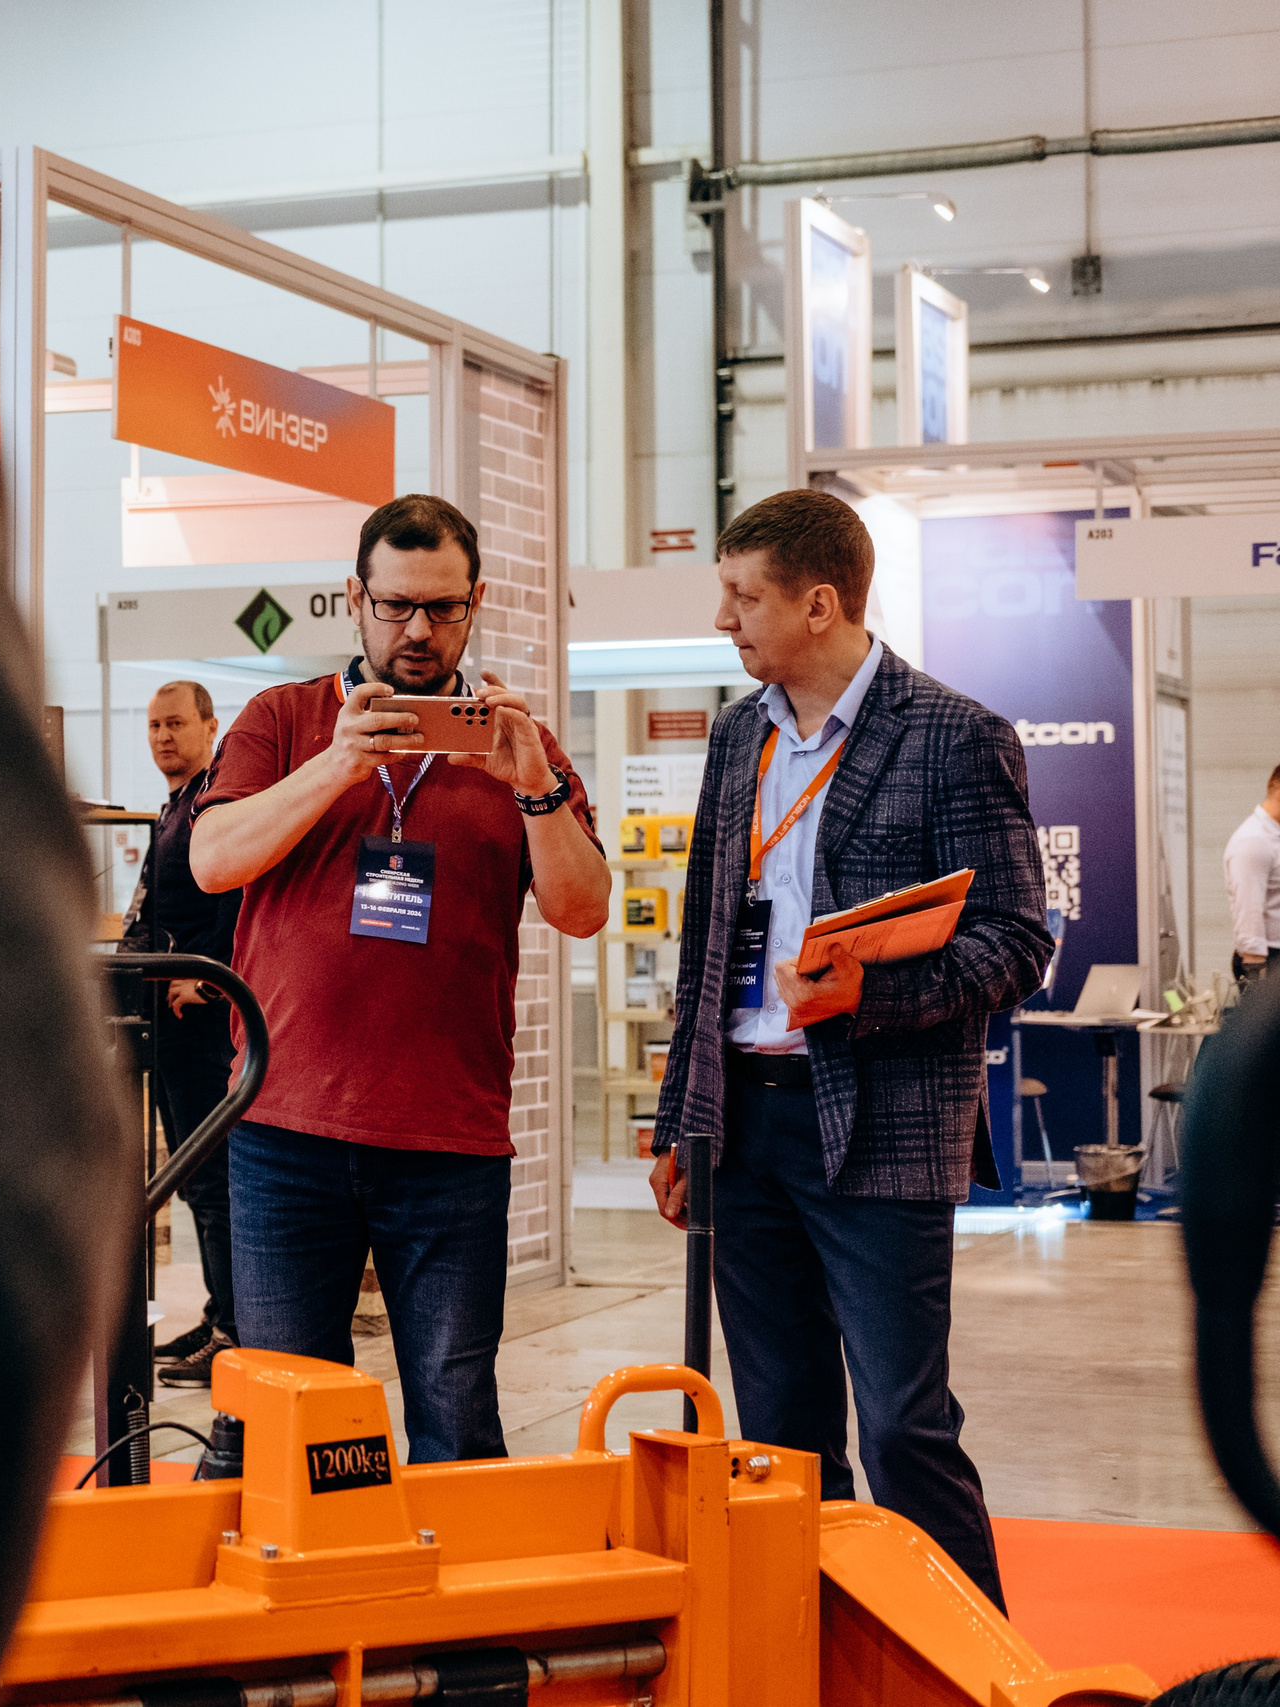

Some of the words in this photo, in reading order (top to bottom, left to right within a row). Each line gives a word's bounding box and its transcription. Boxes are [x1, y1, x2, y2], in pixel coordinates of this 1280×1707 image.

[240, 399, 328, 453] ВИНЗЕР
[1252, 542, 1280, 567] F
[310, 593, 352, 617] ОГ
[778, 794, 811, 837] NOBLELIFT
[366, 872, 405, 881] СТРОИТЕЛЬНАЯ
[380, 869, 410, 877] СИБИРСКАЯ
[378, 905, 406, 915] ФЕВРАЛЯ
[407, 909, 422, 917] 2024
[312, 1444, 388, 1480] 1200kg
